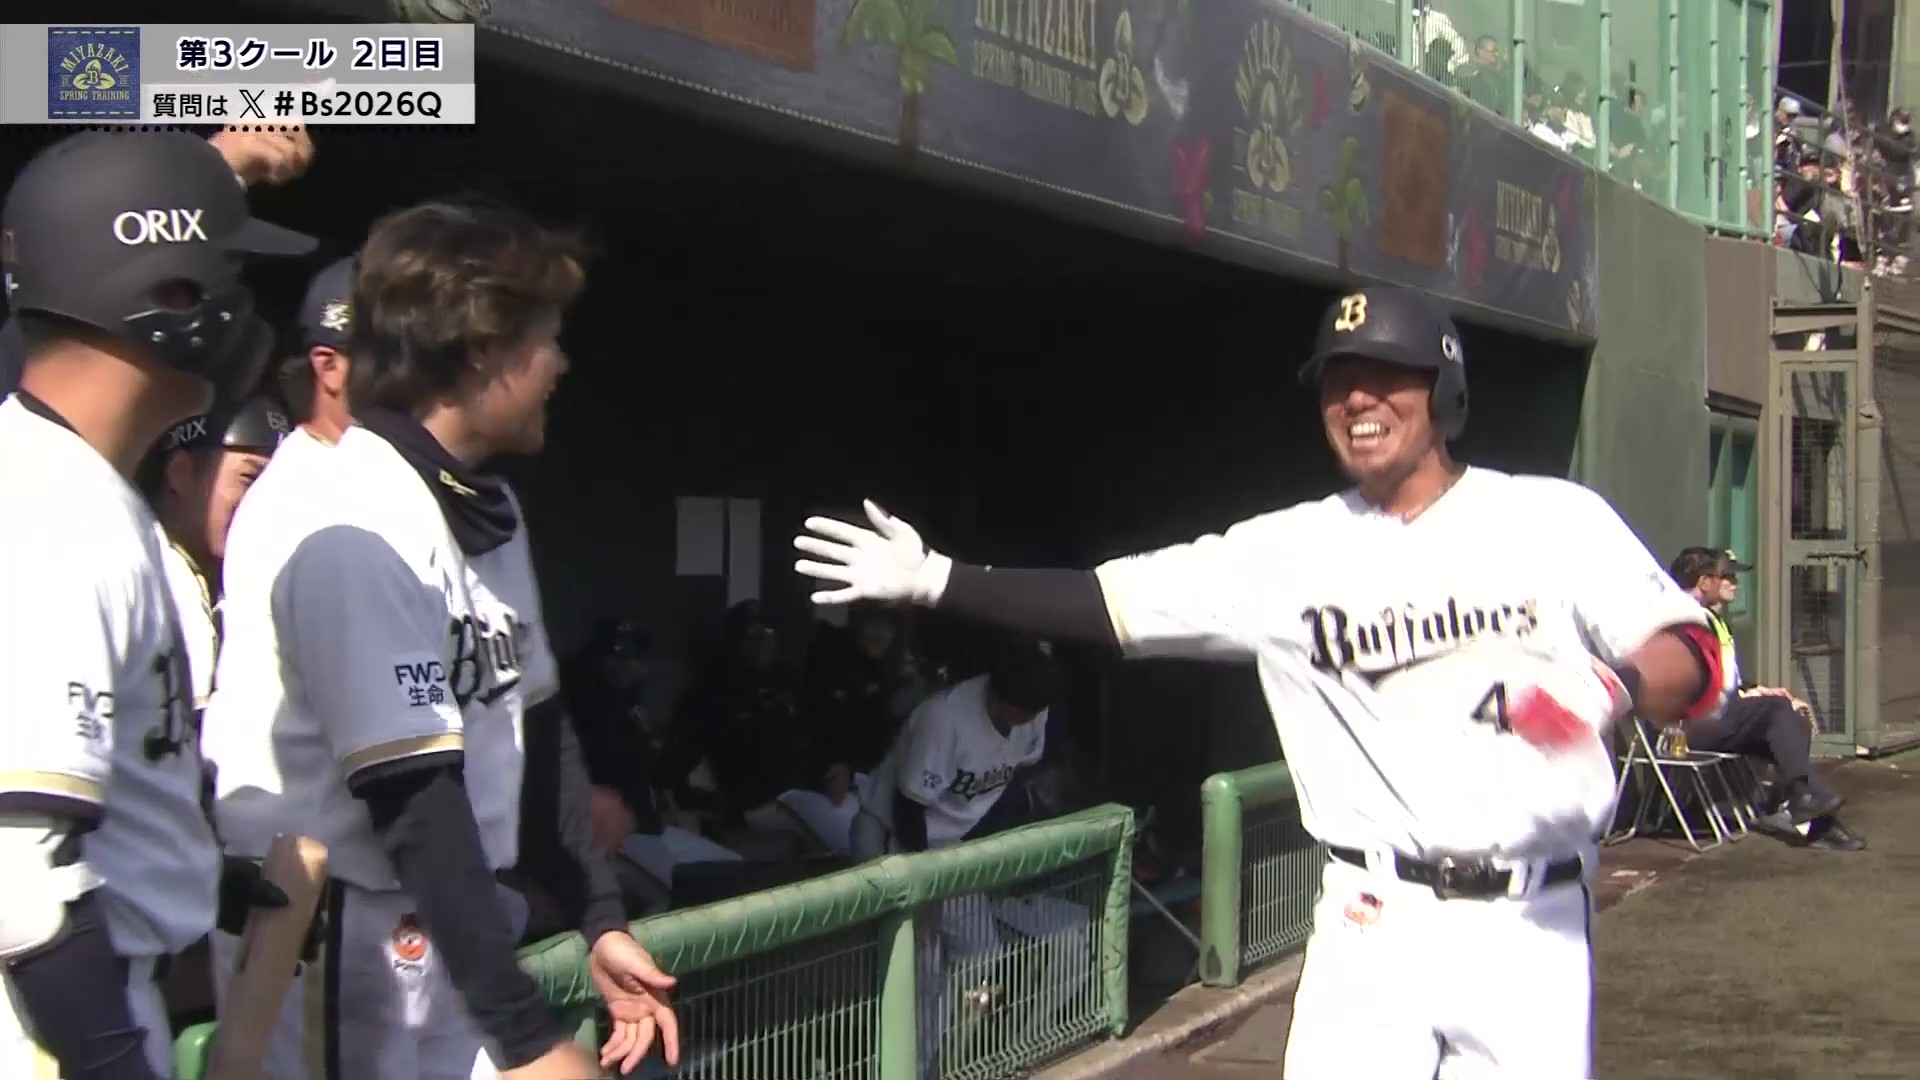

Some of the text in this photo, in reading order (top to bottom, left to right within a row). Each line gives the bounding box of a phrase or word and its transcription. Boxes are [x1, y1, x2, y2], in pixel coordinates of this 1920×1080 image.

[113, 208, 208, 245] ORIX
[1335, 293, 1368, 332] B
[409, 684, 444, 707] 生命
